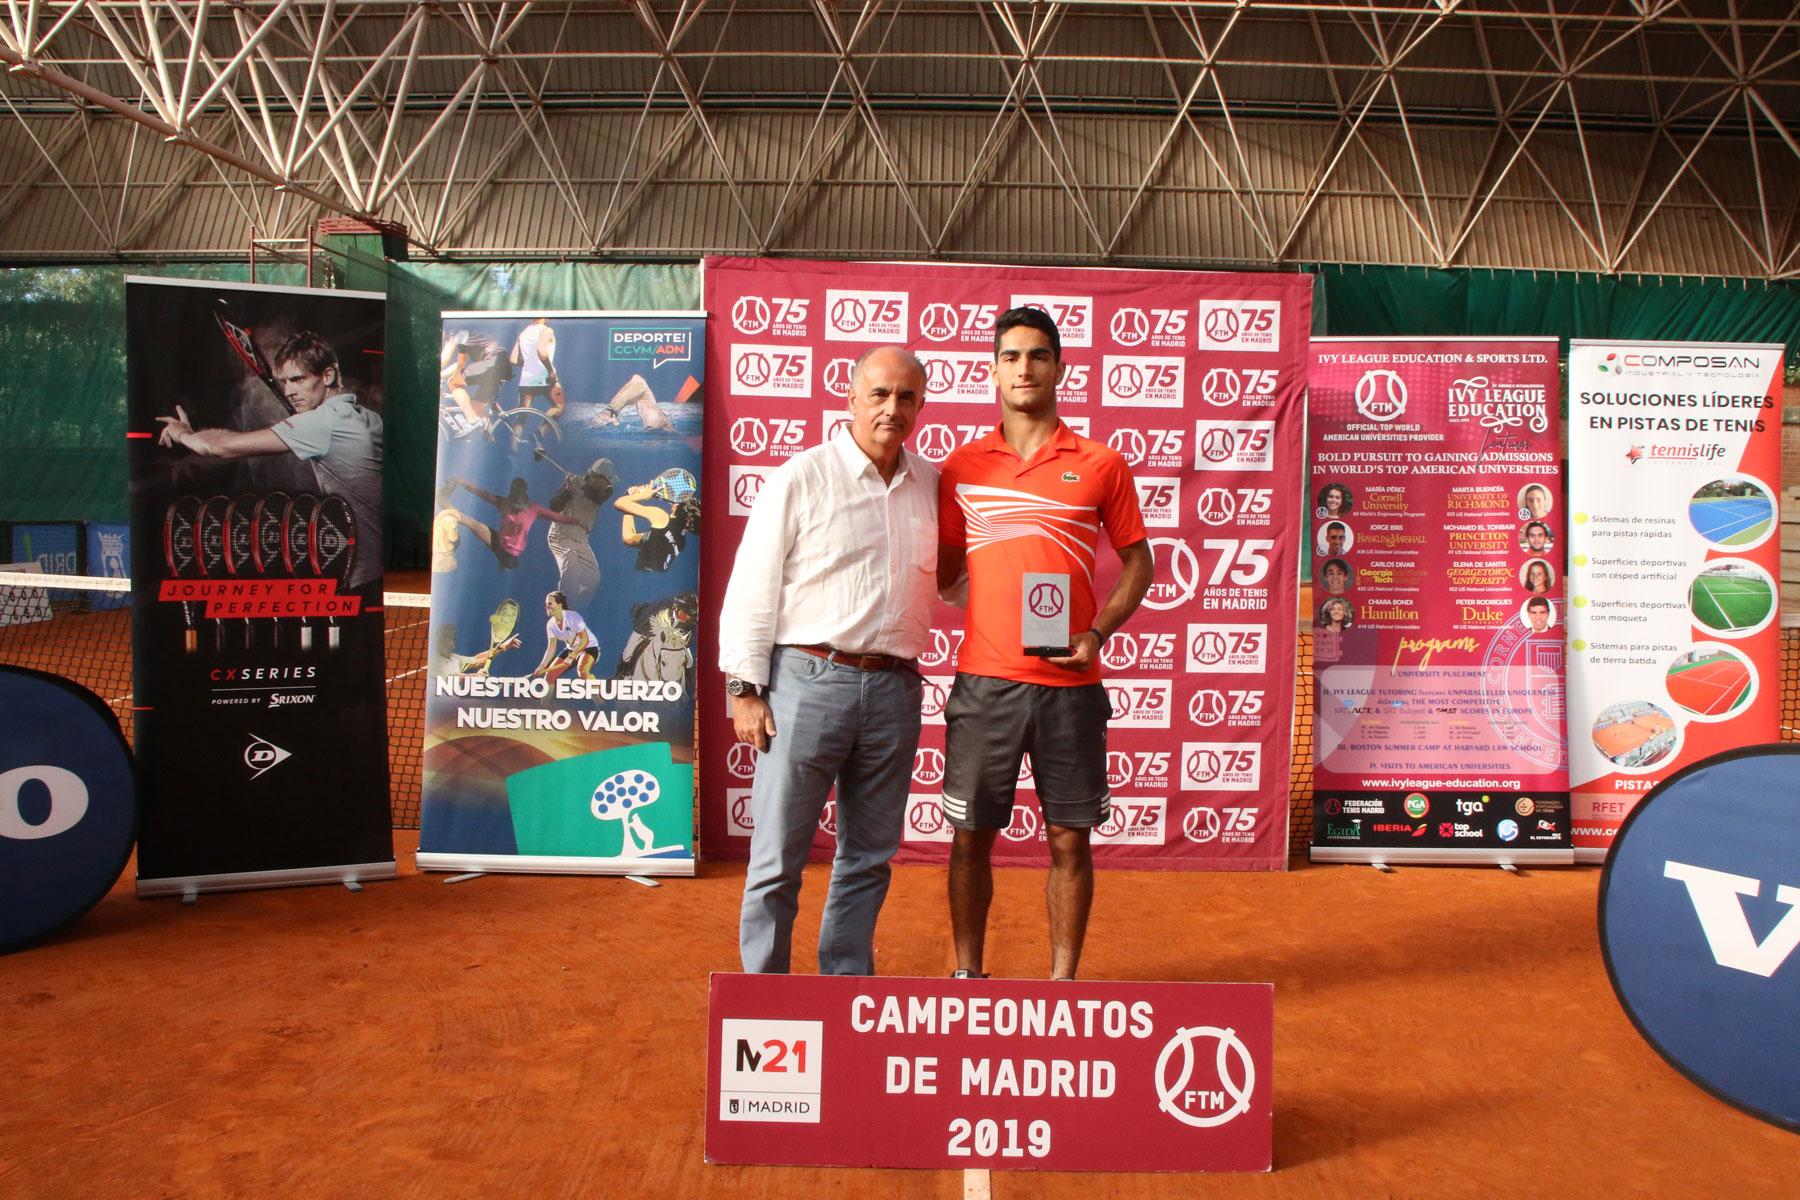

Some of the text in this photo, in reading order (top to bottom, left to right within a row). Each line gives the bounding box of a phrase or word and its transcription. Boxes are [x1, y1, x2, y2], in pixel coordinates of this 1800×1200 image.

[772, 298, 810, 322] 75
[868, 300, 902, 322] 75
[960, 304, 998, 329] 75
[743, 320, 758, 328] FTM
[1150, 309, 1188, 334] 75
[1241, 309, 1275, 330] 75
[614, 333, 685, 342] DEPORTE!
[1122, 332, 1138, 340] FTM
[1318, 354, 1548, 363] IVY LEAGUE EDUCATION & SPORTS LTD.
[1624, 354, 1760, 368] COMPOSAN
[772, 355, 806, 377] 75
[956, 360, 992, 382] 75
[1145, 365, 1180, 387] 75
[1241, 370, 1279, 394] 75
[1213, 392, 1229, 400] FTM
[1485, 389, 1546, 403] LEAGUE
[1580, 392, 1774, 408] SOLUCIONES LÍDERES
[1371, 403, 1392, 412] FTM
[1590, 416, 1765, 432] EN PISTAS DE TENIS
[769, 419, 806, 444] 75
[741, 442, 756, 450] FTM
[1650, 443, 1726, 460] tennislife
[1318, 452, 1553, 462] BOLD PURSUIT TO GAINING ADMISSIONS
[1313, 465, 1558, 474] IN WORLD'S TOP AMERICAN UNIVERSITIES
[1141, 485, 1175, 507] 75
[1236, 489, 1274, 513] 75
[1370, 493, 1403, 501] Cornell
[1363, 501, 1408, 510] University
[1447, 500, 1509, 509] RICHMOND
[1592, 515, 1675, 525] Sistemas de resinas
[1450, 532, 1509, 540] PRINCETON
[1592, 529, 1672, 539] para pistas rápidas
[1450, 542, 1508, 550] UNIVERSITY
[1203, 539, 1274, 586] 75
[1592, 558, 1687, 568] Superficies deportivas
[1360, 569, 1392, 577] Georgia
[1447, 568, 1514, 577] GEORGETOWN
[1609, 571, 1638, 581] césped
[1641, 572, 1677, 580] artificial
[167, 583, 328, 597] JOURNEY FOR
[1147, 583, 1176, 598] FTM
[1204, 588, 1267, 597] AÑOS DE TENIS
[214, 601, 353, 613] PERFECTION
[1203, 598, 1267, 610] EN MADRID
[1591, 600, 1686, 610] Superficies deportivas
[1360, 606, 1419, 620] Hamilton
[1463, 607, 1503, 621] Duke
[1608, 614, 1647, 623] moqueta
[1139, 633, 1176, 657] 75
[1228, 632, 1262, 653] 75
[1590, 642, 1677, 653] Sistemas para pistas
[1393, 637, 1480, 672] programs
[1590, 656, 1657, 665] de tierra batida
[436, 676, 682, 702] NUESTRO ESFUERZO
[268, 693, 315, 708] SRIXON
[1228, 690, 1264, 714] 75
[457, 707, 659, 732] NUESTRO VALOR
[1134, 752, 1171, 775] 75
[1222, 750, 1255, 772] 75
[1362, 778, 1520, 790] www.ivyleague-education.org
[1408, 800, 1425, 808] PGA
[1456, 799, 1483, 816] tga
[1592, 802, 1625, 812] RFET
[1222, 807, 1258, 831] 75
[851, 995, 1153, 1038] CAMPEONATOS
[736, 1038, 806, 1074] M21
[886, 1056, 1116, 1098] DE MADRID
[748, 1100, 810, 1114] MADRID
[1185, 1092, 1224, 1109] FTM
[948, 1118, 1051, 1157] 2019
